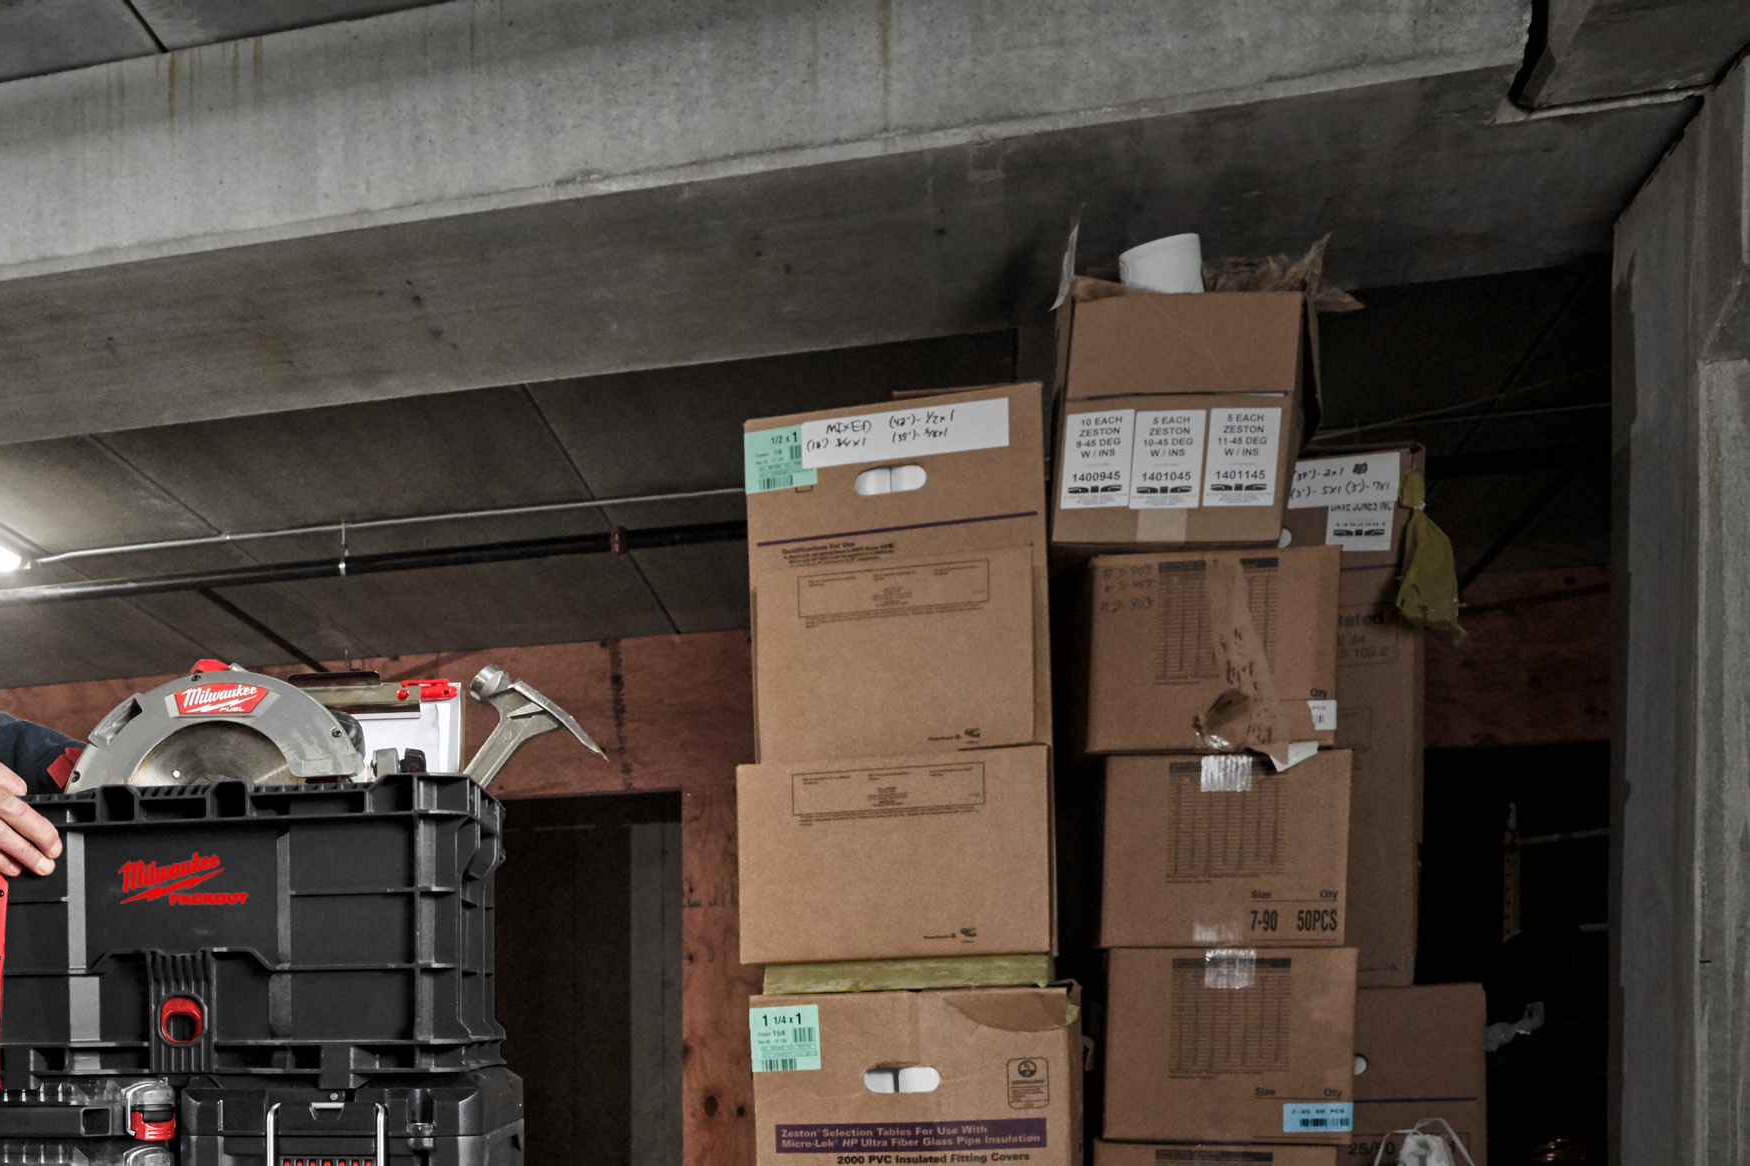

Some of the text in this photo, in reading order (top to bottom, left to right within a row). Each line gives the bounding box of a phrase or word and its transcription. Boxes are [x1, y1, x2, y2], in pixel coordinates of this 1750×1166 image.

[1080, 416, 1123, 427] 10 EACH
[1152, 416, 1190, 424] 5 EACH
[1227, 414, 1264, 422] 5 EACH
[826, 420, 872, 434] MIXED
[1079, 426, 1121, 437] ZESTON
[1149, 427, 1190, 436] ZESTON
[1223, 425, 1264, 434] ZESTON
[770, 435, 783, 445] 1/2
[792, 431, 798, 442] 1
[1076, 438, 1121, 448] 9-45 DEG
[1143, 438, 1194, 447] 10-45 DEG
[1217, 436, 1268, 446] 11-45 DEG
[1080, 450, 1092, 458] W
[1098, 448, 1116, 457] INS
[1150, 449, 1161, 458] W
[1168, 448, 1186, 456] INS
[1224, 448, 1235, 456] W
[1242, 448, 1259, 456] INS
[1072, 470, 1121, 482] 1400945
[1141, 472, 1192, 482] 1401045
[1215, 470, 1266, 480] 1401145
[1330, 502, 1350, 512] DAVE
[1352, 502, 1378, 511] JONES
[181, 684, 258, 708] Milwaukee
[1310, 688, 1328, 698] Qty
[118, 852, 220, 894] Milwaukee
[170, 892, 248, 905] PACKOUT
[1251, 889, 1338, 900] Size Qty
[1250, 909, 1338, 932] 7-90 50PCS
[762, 1014, 768, 1027] 1
[774, 1016, 786, 1025] 1/4
[795, 1012, 802, 1025] 1
[1254, 1087, 1342, 1099] Size Qty
[822, 1128, 874, 1137] Selection
[876, 1127, 912, 1136] Tables
[915, 1126, 934, 1136] For
[937, 1126, 958, 1135] Use
[962, 1125, 988, 1134] With
[842, 1138, 858, 1148] HP
[860, 1138, 888, 1148] Ultra
[891, 1137, 920, 1147] Fiber
[922, 1137, 953, 1146] Glass
[956, 1136, 981, 1147] Pipe
[985, 1134, 1040, 1145] Insulation
[837, 1152, 1030, 1165] 2000 PVC Insulated Fitting Covers
